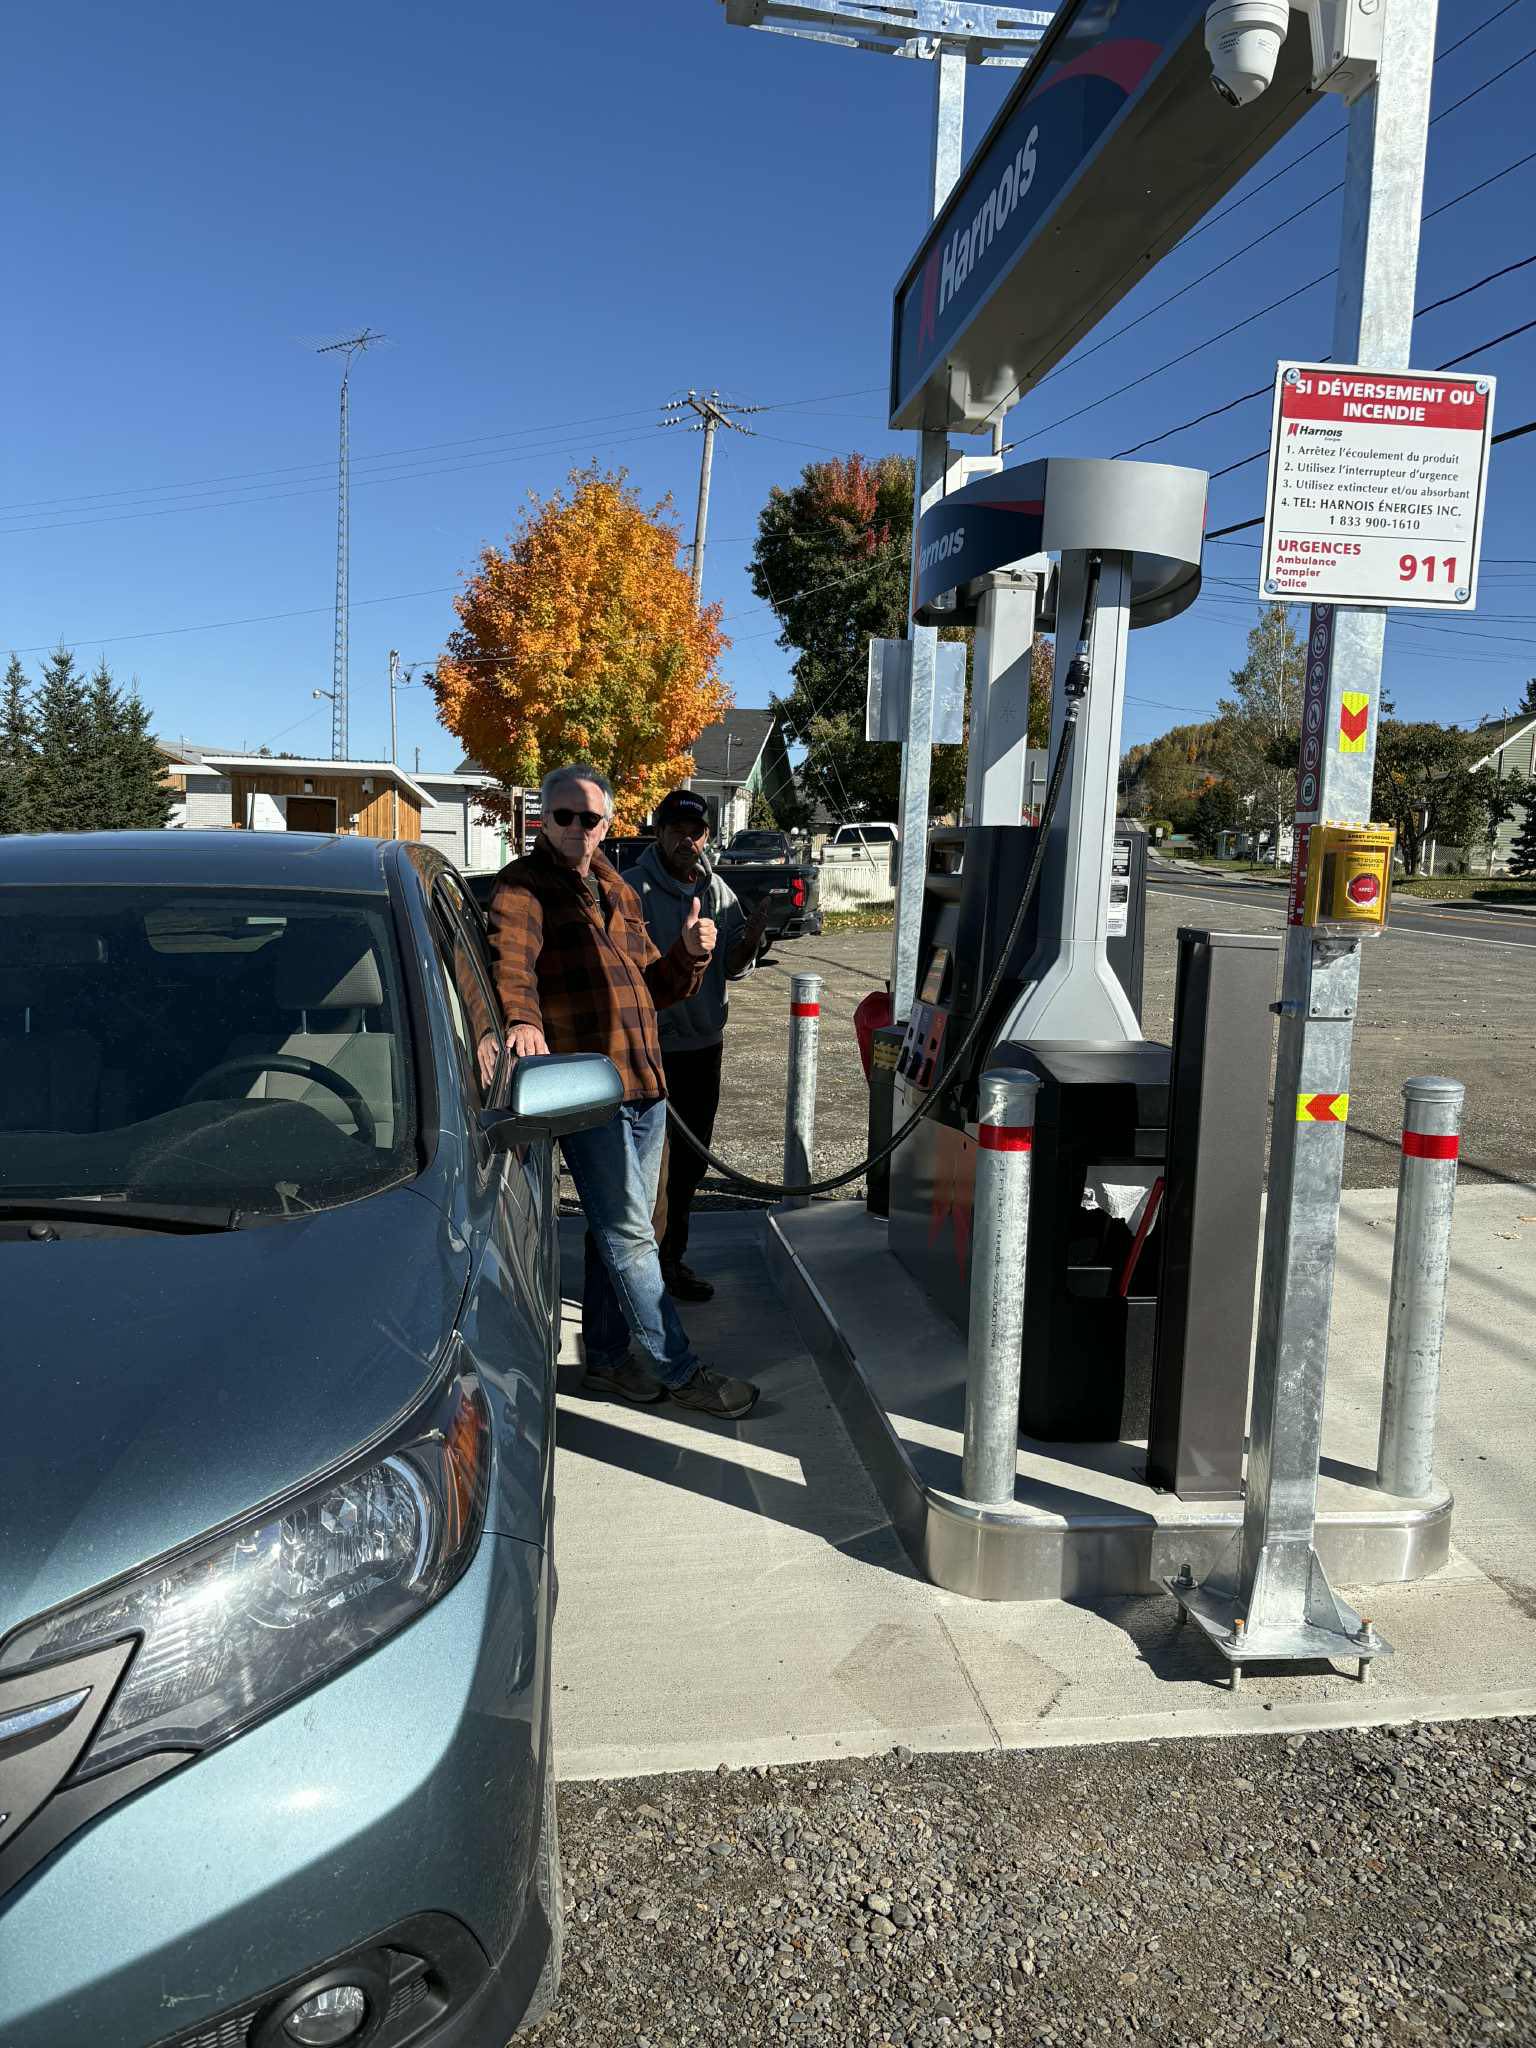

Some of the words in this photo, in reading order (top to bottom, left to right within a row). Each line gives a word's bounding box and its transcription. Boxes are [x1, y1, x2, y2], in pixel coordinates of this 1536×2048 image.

[938, 124, 1040, 316] Harnois
[1296, 381, 1312, 393] SI
[1317, 379, 1445, 404] DÉVERSEMENT
[1450, 391, 1475, 404] OU
[1343, 404, 1426, 421] INCENDIE
[1300, 426, 1342, 437] Harnois
[1287, 445, 1294, 454] 1.
[1298, 446, 1336, 457] Arrêtez
[1407, 452, 1419, 462] du
[1422, 454, 1459, 465] produit
[1284, 463, 1293, 471] 2.
[1297, 463, 1335, 474] Utilisez
[1283, 480, 1292, 488] 3.
[1296, 480, 1334, 490] Utilisez
[1337, 483, 1388, 494] extincteur
[1391, 486, 1418, 496] et/ou
[1421, 487, 1470, 499] absorbant
[1281, 497, 1290, 507] 4.
[1293, 498, 1316, 508] TEL:
[1320, 499, 1374, 512] HARNOIS
[1378, 499, 1433, 515] ÉNERGIES
[1436, 505, 1461, 516] INC.
[1329, 515, 1335, 525] 1
[1339, 516, 1361, 527] 833
[1366, 518, 1420, 529] 900-1610
[920, 527, 966, 574] arnois
[1278, 540, 1361, 555] URGENCES
[1276, 556, 1337, 567] Ambulance
[1399, 554, 1457, 583] 911
[1275, 567, 1321, 578] Pompier
